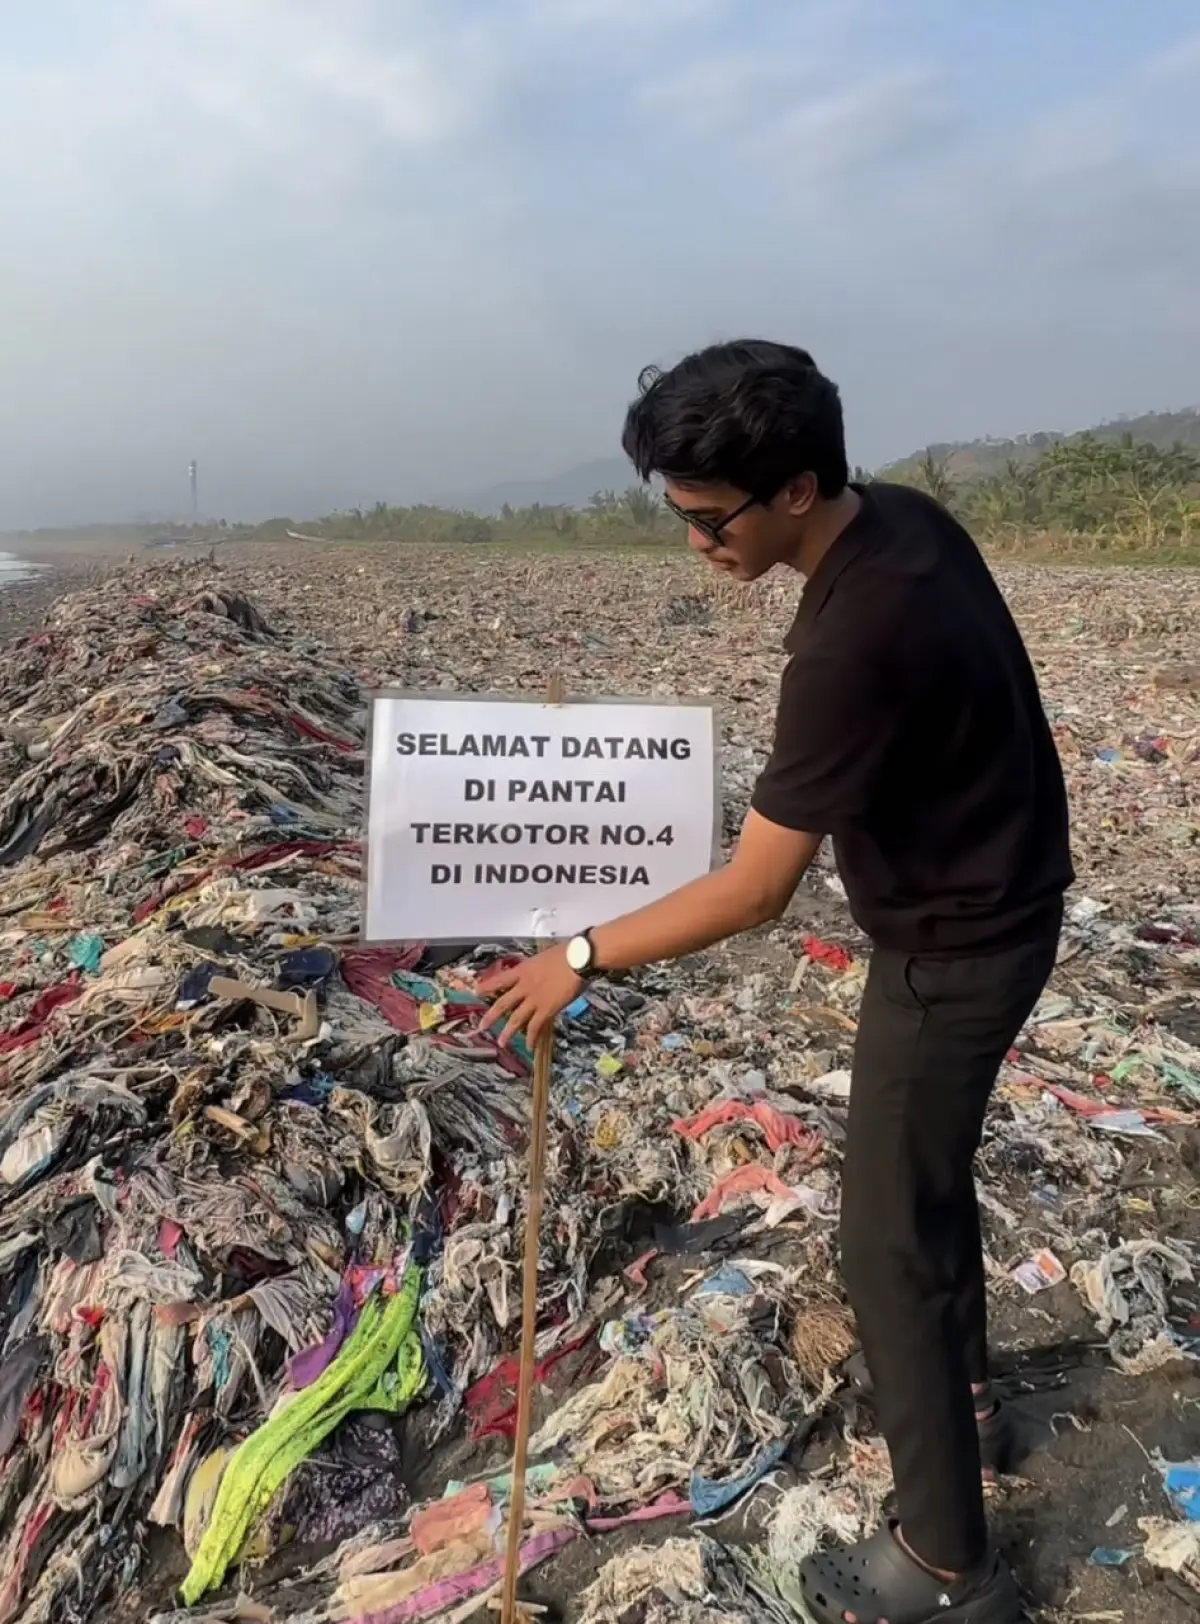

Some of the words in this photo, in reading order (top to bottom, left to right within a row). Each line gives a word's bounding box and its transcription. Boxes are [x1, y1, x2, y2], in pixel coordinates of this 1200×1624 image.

[396, 733, 551, 757] SELAMAT
[562, 736, 691, 760] DATANG
[464, 779, 495, 802] DI
[508, 779, 626, 803] PANTAI
[410, 823, 590, 845] TERKOTOR
[600, 824, 674, 846] NO.4
[430, 864, 462, 885] DI
[474, 864, 650, 886] INDONESIA
